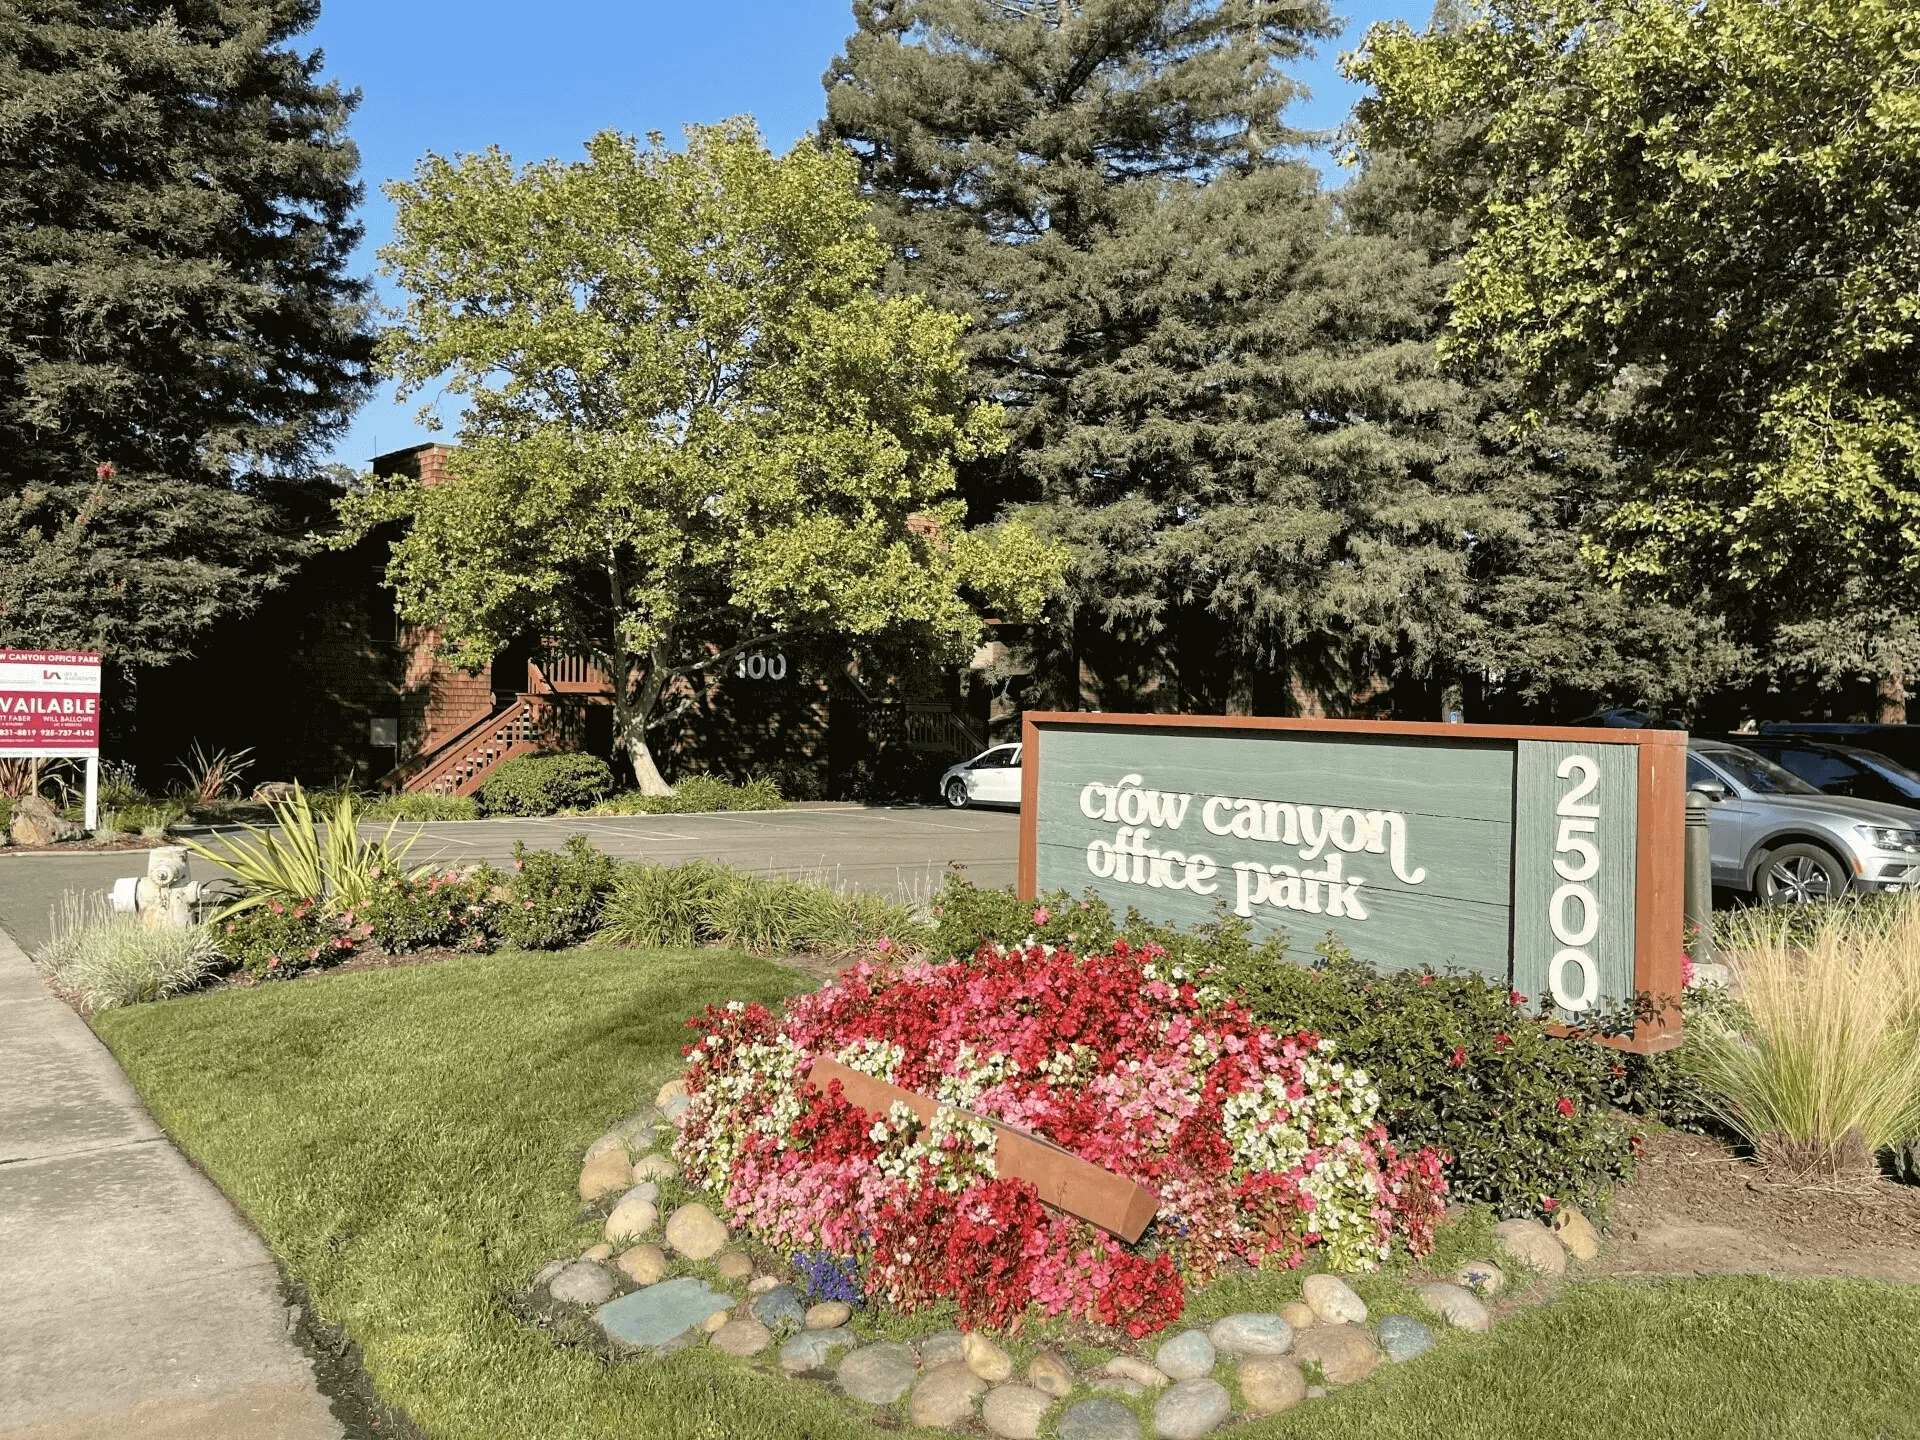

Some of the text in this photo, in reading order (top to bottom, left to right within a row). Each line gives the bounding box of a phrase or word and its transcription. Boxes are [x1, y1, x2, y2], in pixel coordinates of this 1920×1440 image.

[9, 654, 46, 662] CANYON
[48, 655, 76, 663] OFFICE
[735, 652, 786, 680] 100
[1080, 774, 1426, 885] crow canyon
[1087, 827, 1367, 921] office park
[1549, 755, 1600, 1012] 2500
